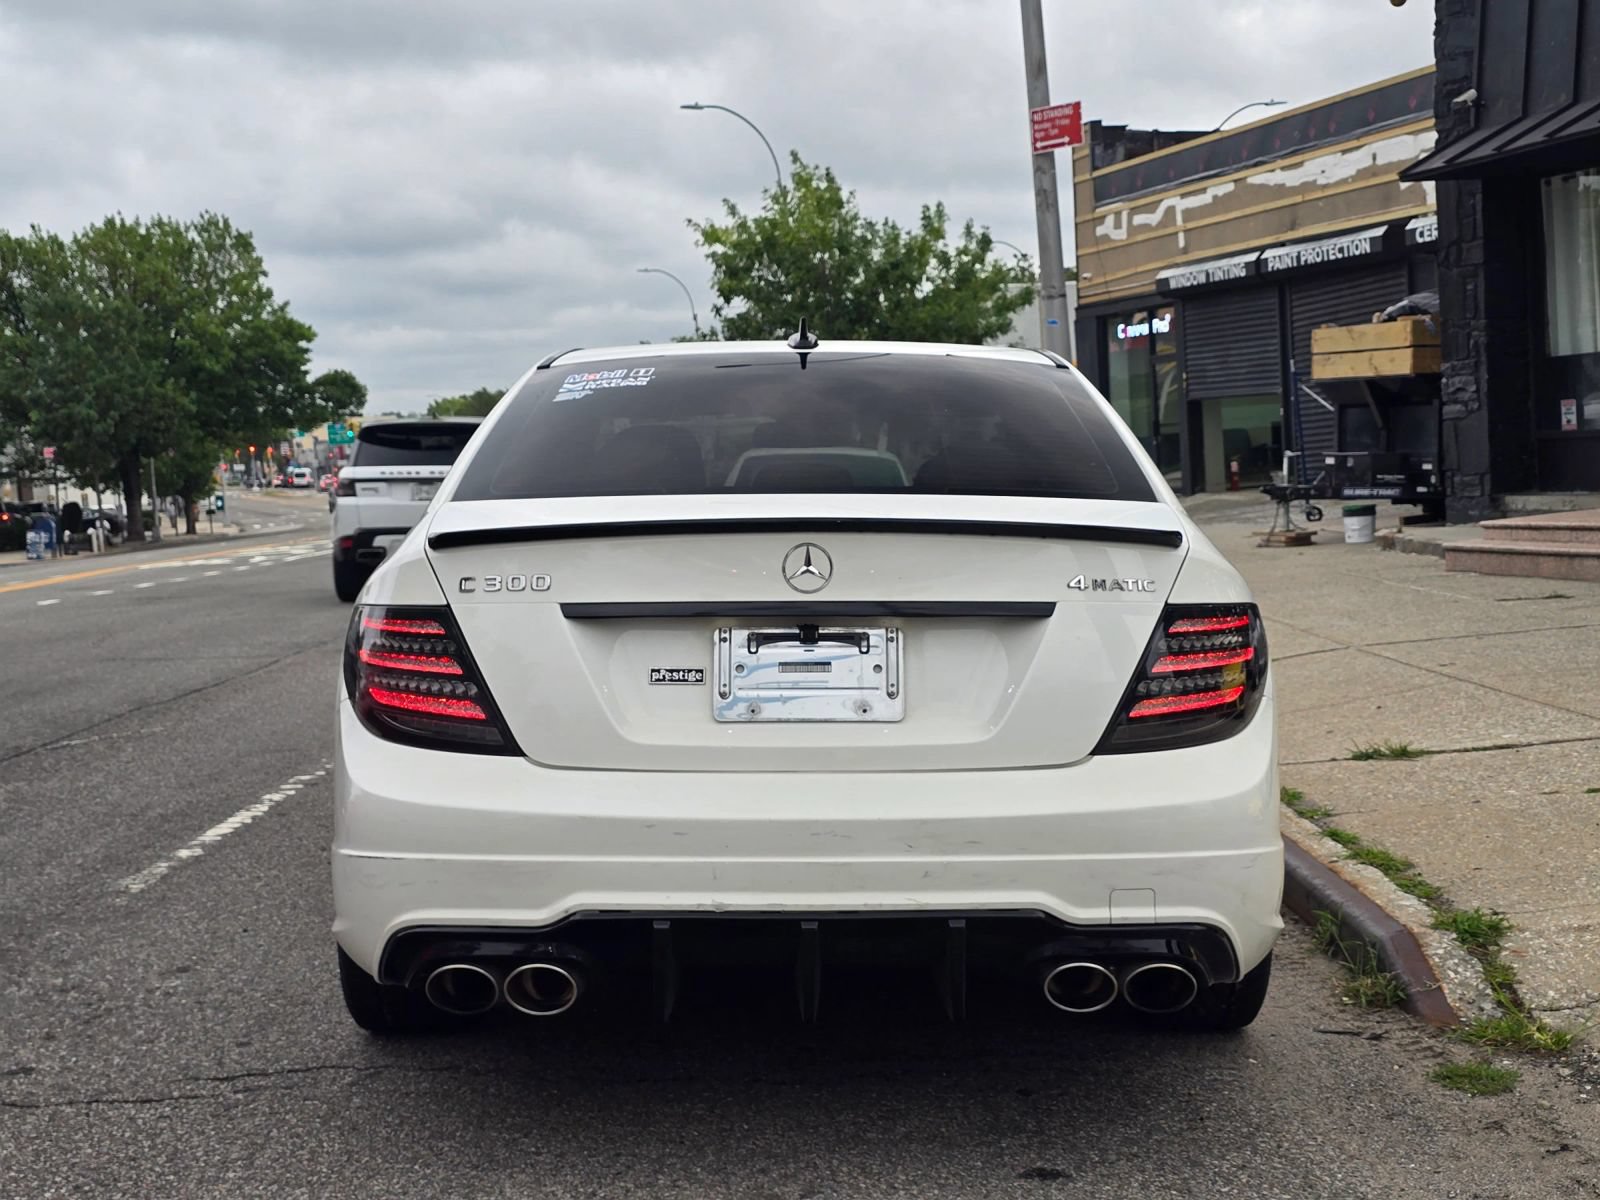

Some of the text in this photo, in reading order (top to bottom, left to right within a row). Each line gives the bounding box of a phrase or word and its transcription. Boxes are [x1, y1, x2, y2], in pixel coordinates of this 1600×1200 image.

[1033, 106, 1073, 122] NO STANDING
[1267, 238, 1371, 272] PAINT PROTECTION
[1168, 263, 1246, 289] WINDOW TINTING
[565, 369, 627, 383] Mobil
[651, 669, 703, 682] prestige
